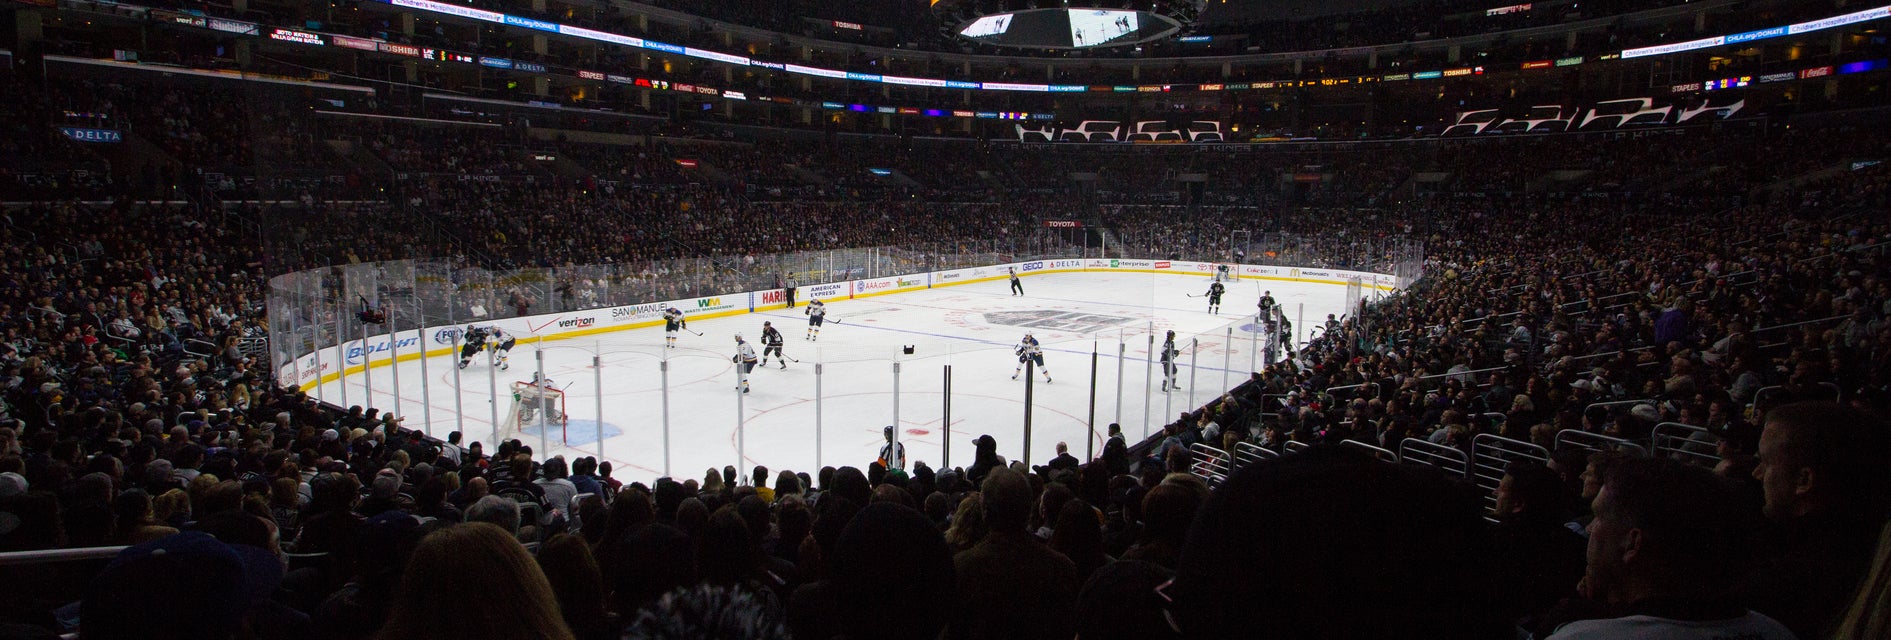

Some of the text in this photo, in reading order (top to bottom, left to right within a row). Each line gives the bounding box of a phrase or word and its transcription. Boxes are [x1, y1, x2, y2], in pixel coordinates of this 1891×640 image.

[176, 17, 206, 28] verion
[508, 16, 556, 31] CHLA.org/DONATE
[835, 21, 861, 30] TOSHIBA
[1791, 9, 1887, 32] Children's Hospital Los Angeles
[1727, 27, 1783, 42] CHLA.org/DONATE
[1625, 48, 1653, 57] Children's
[1654, 45, 1679, 53] Hospital
[1690, 40, 1713, 48] Angeles
[522, 63, 546, 72] DELTA
[1443, 68, 1471, 77] TOSHIBA
[579, 70, 604, 79] STAPLES
[697, 86, 718, 96] TOYOTA
[1672, 82, 1699, 92] STAPLES
[76, 130, 121, 141] DELTA
[1056, 260, 1080, 269] DELTA
[1112, 260, 1149, 268] enterprise
[1209, 264, 1236, 272] TOTA
[810, 284, 841, 293] AMERICAN
[866, 280, 891, 289] AAA.com
[762, 290, 787, 305] HARI
[810, 290, 836, 298] EXPRESS
[698, 297, 721, 308] WM
[612, 308, 630, 318] SAN
[703, 304, 734, 312] MANAGEMENT
[559, 317, 595, 329] verizon
[376, 337, 418, 352] LIHT
